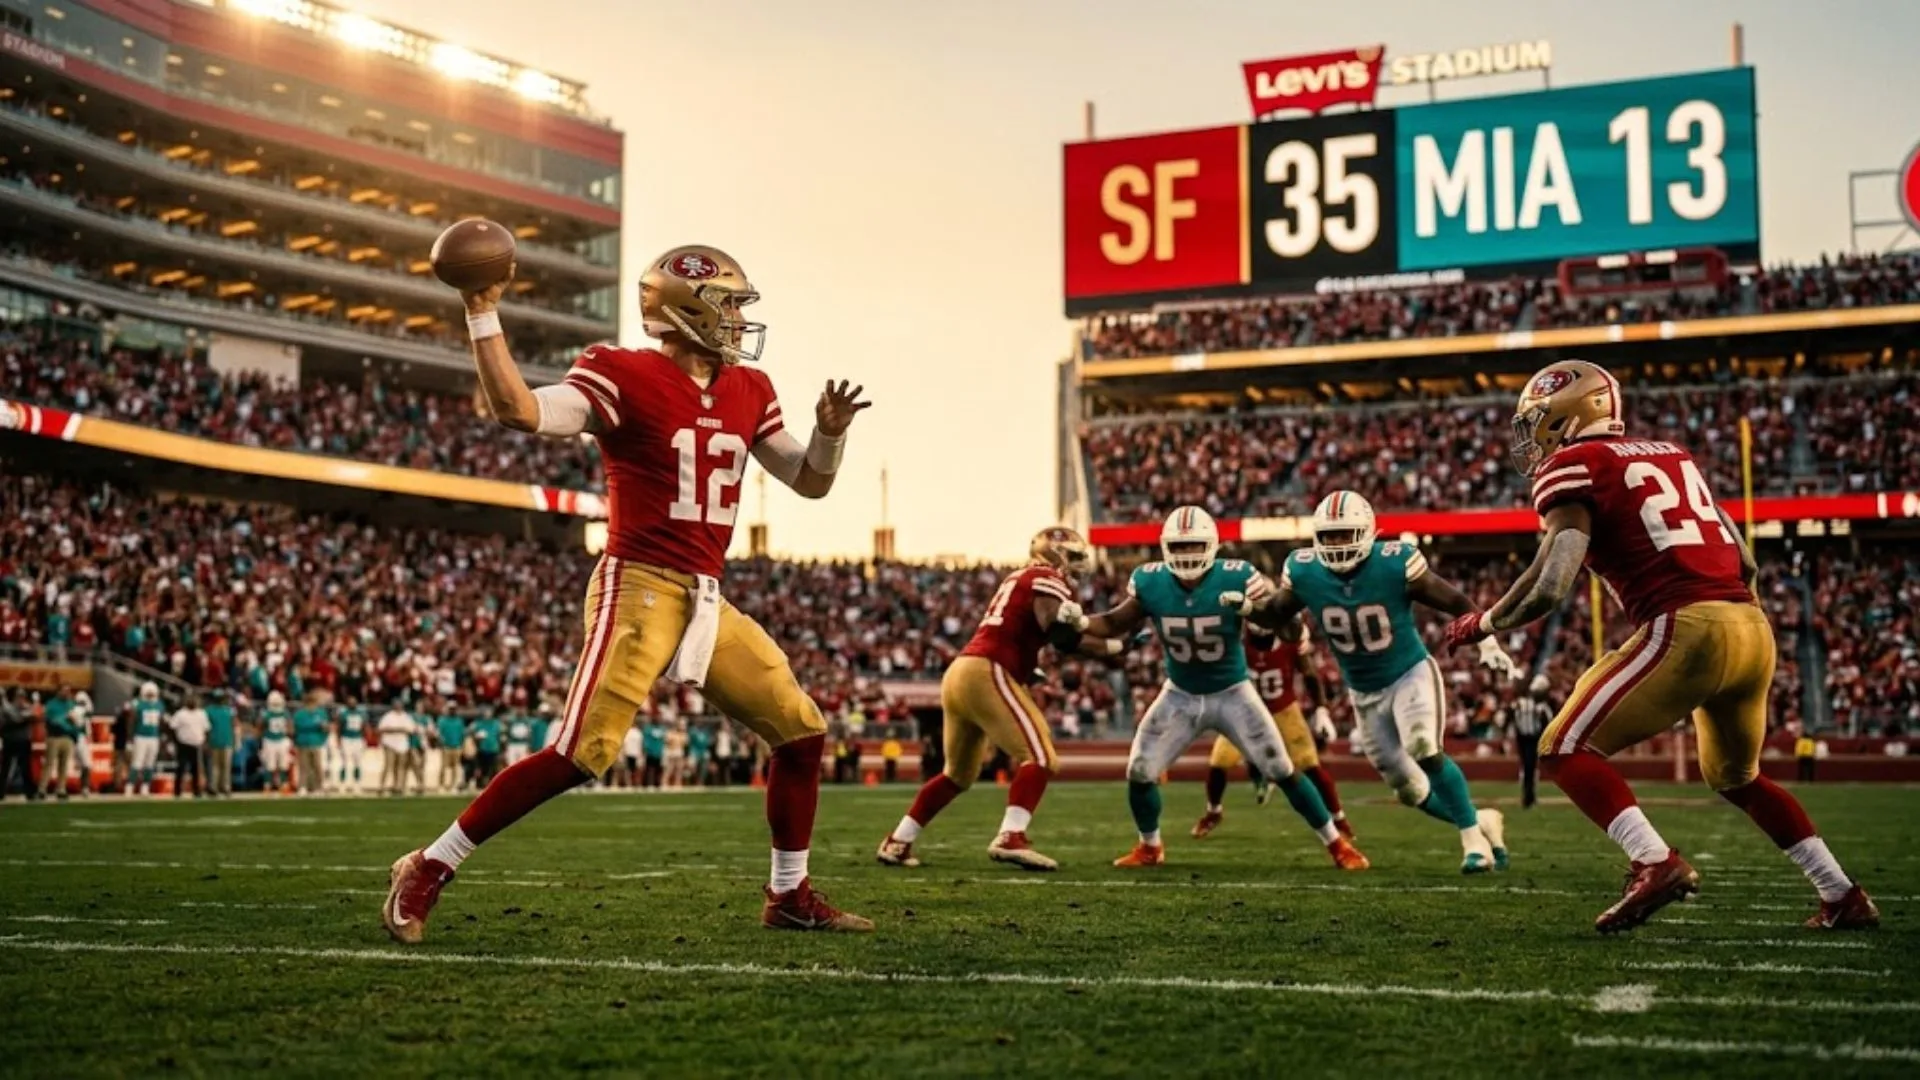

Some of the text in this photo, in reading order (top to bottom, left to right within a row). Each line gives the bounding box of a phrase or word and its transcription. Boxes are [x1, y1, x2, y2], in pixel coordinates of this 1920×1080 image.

[1391, 40, 1551, 84] STADIUM
[1100, 100, 1727, 265] SF 35 MIA 13
[669, 427, 747, 526] 12
[1624, 459, 1735, 552] 24
[1161, 615, 1224, 663] 55
[1322, 604, 1393, 653] 90
